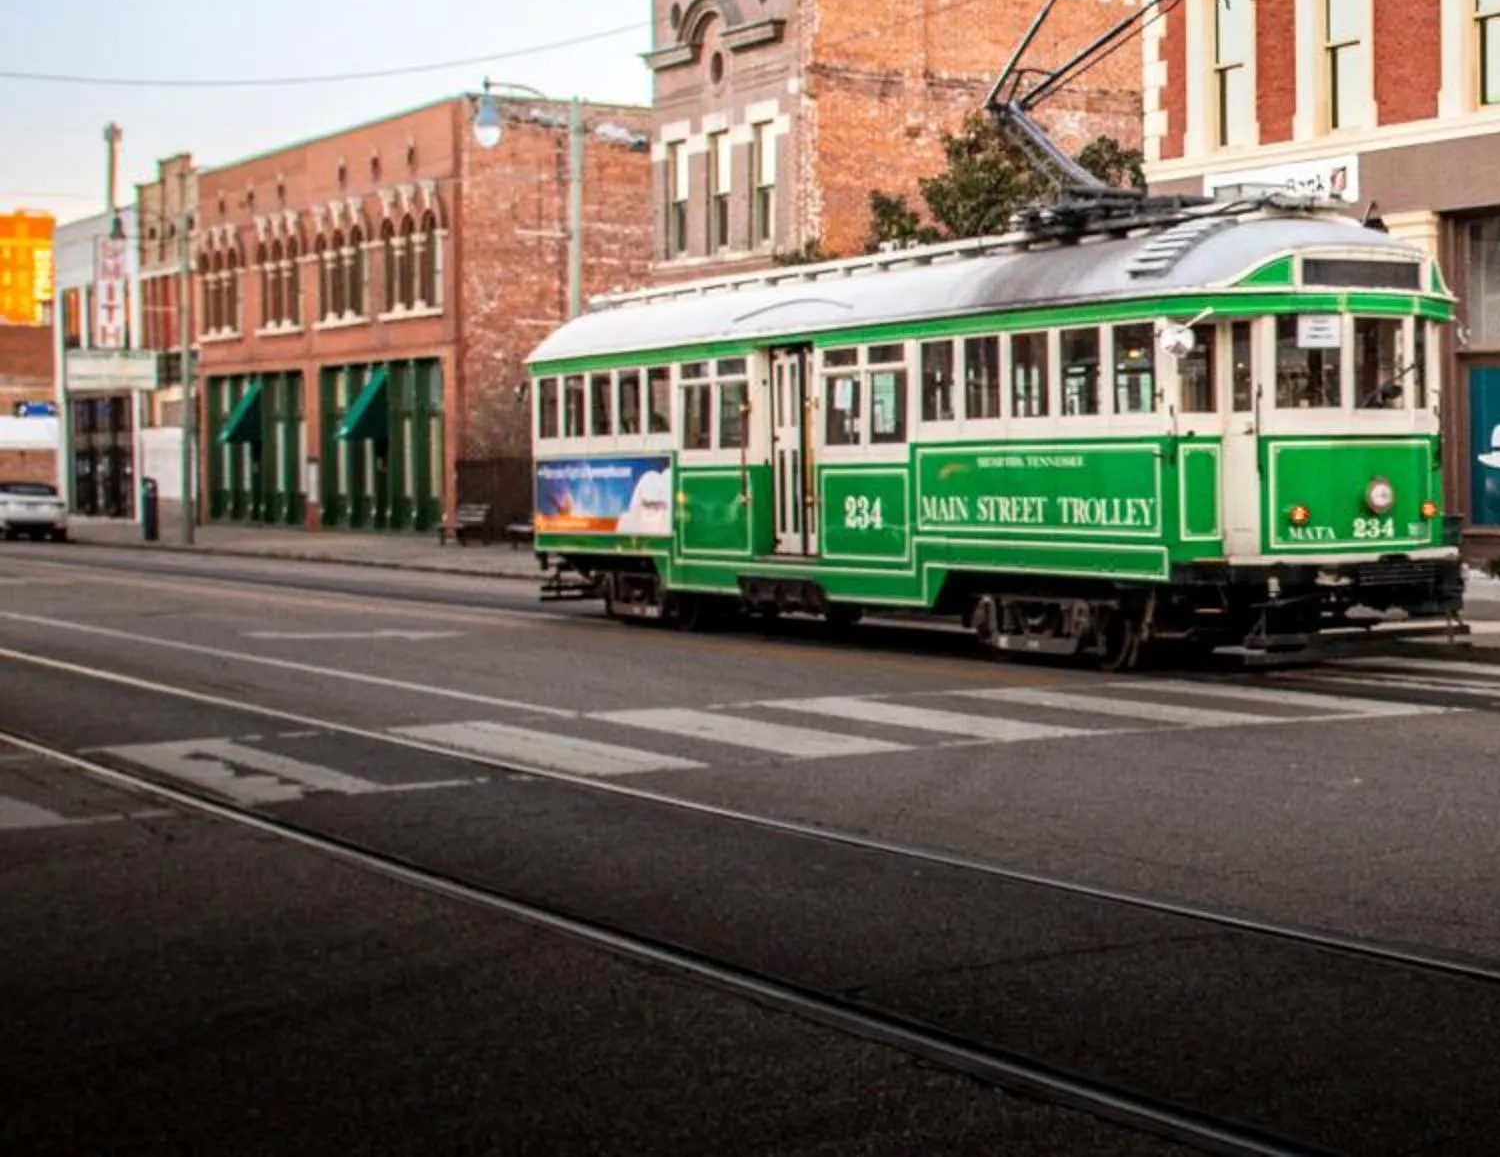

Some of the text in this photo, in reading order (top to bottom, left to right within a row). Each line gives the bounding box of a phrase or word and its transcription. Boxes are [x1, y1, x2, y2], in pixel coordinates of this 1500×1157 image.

[844, 494, 882, 530] 234
[922, 495, 1154, 526] MAIN STREET TROLLEY
[1288, 526, 1336, 540] MATA
[1353, 517, 1395, 539] 234
